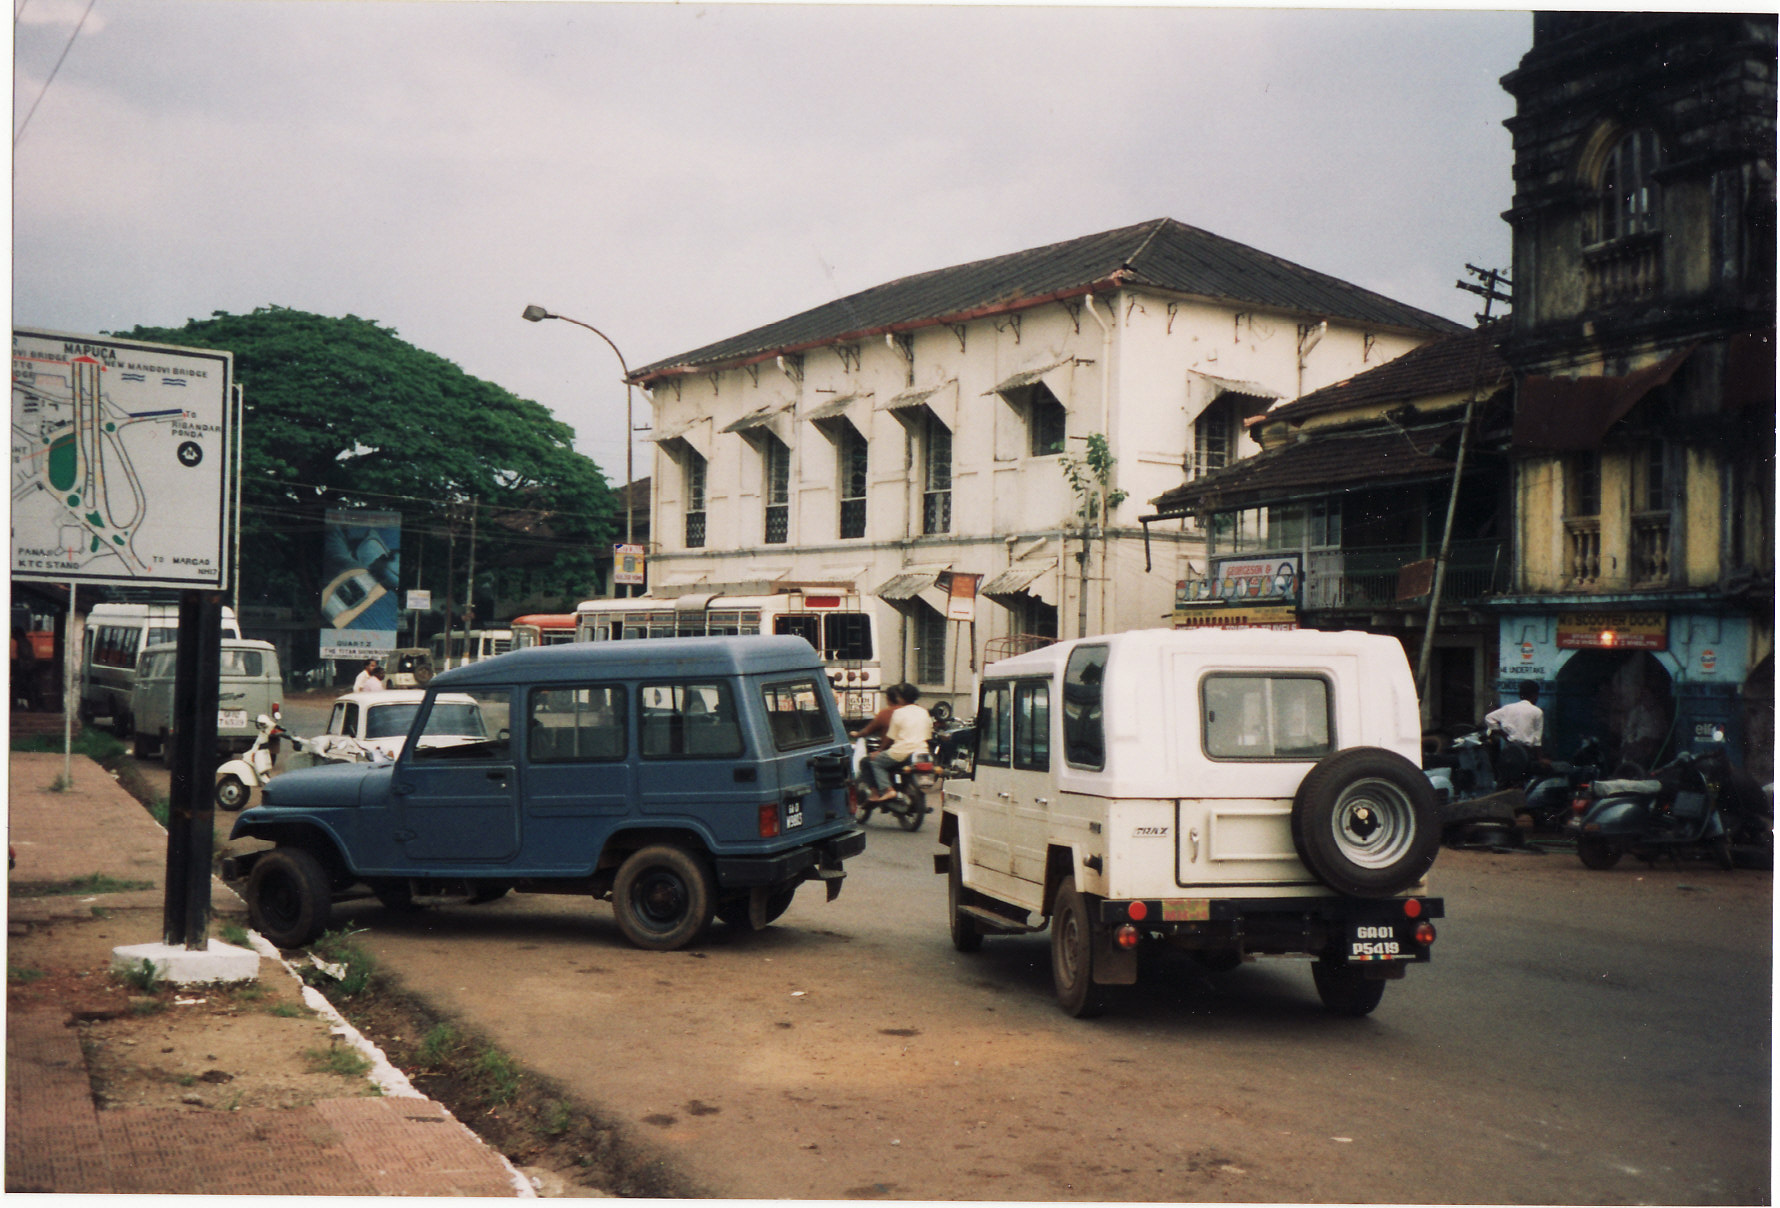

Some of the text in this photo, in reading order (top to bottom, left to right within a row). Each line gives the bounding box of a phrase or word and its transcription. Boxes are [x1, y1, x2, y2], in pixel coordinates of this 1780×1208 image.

[30, 351, 67, 362] BRIDGE
[64, 343, 116, 360] MAPUCA
[104, 360, 208, 378] NEW MANDOVI BRIDGE
[171, 421, 221, 433] RIBANDAR
[171, 430, 204, 439] PONDA
[46, 561, 80, 571] STAND
[152, 556, 211, 566] TO MARGAO
[1575, 614, 1627, 627] SCOOTER
[1629, 614, 1663, 627] DOCK
[1509, 666, 1545, 674] UNDERTAKE
[1136, 827, 1169, 836] TRAX
[1357, 926, 1394, 939] GA01
[1352, 942, 1400, 955] P5419
